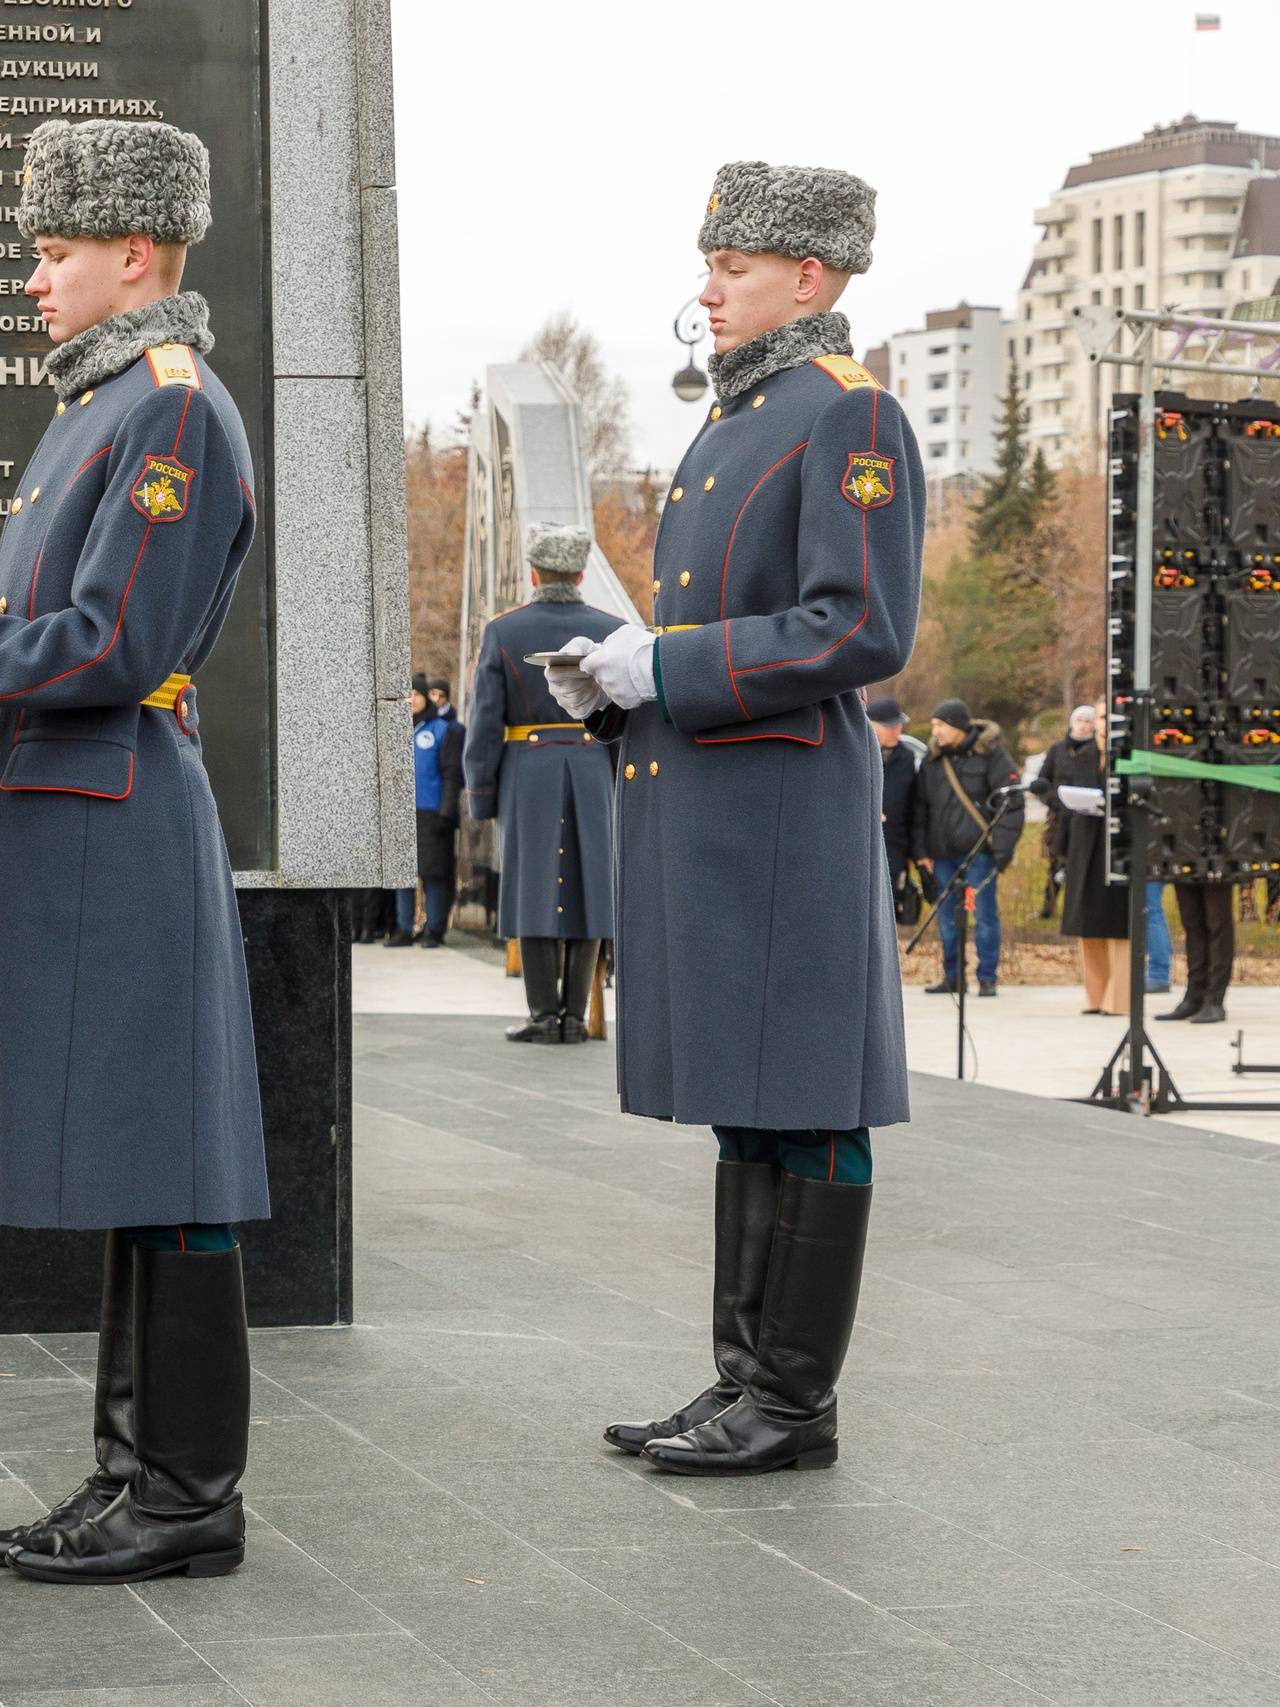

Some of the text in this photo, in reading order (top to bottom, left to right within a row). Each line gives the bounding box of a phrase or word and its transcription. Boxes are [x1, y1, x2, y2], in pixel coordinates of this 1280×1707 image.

[86, 27, 102, 43] И
[149, 460, 188, 481] РОССИЯ
[852, 457, 889, 469] РОССИЯ
